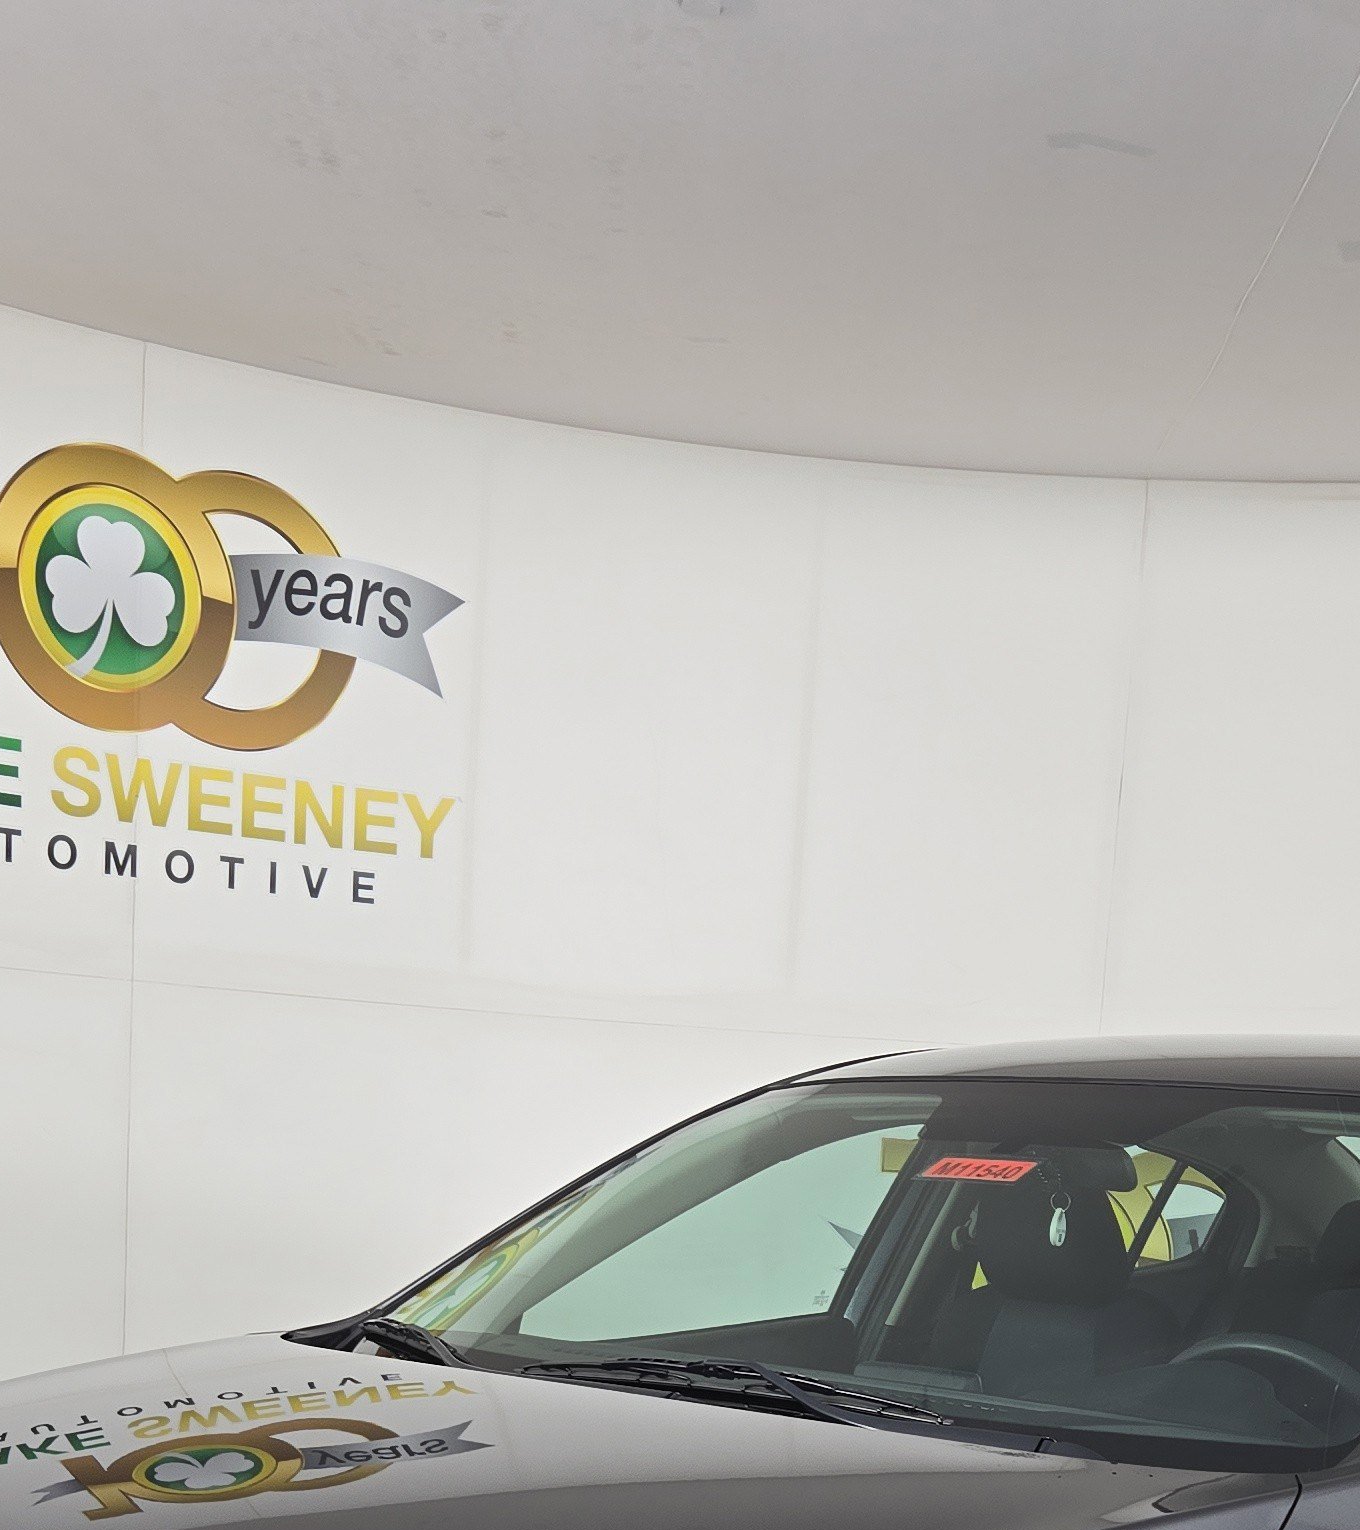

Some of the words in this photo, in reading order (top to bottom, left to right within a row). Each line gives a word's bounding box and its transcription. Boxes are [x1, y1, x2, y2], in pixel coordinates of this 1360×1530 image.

[246, 567, 412, 640] years
[49, 744, 457, 861] SWEENEY
[931, 1161, 1024, 1180] M11540
